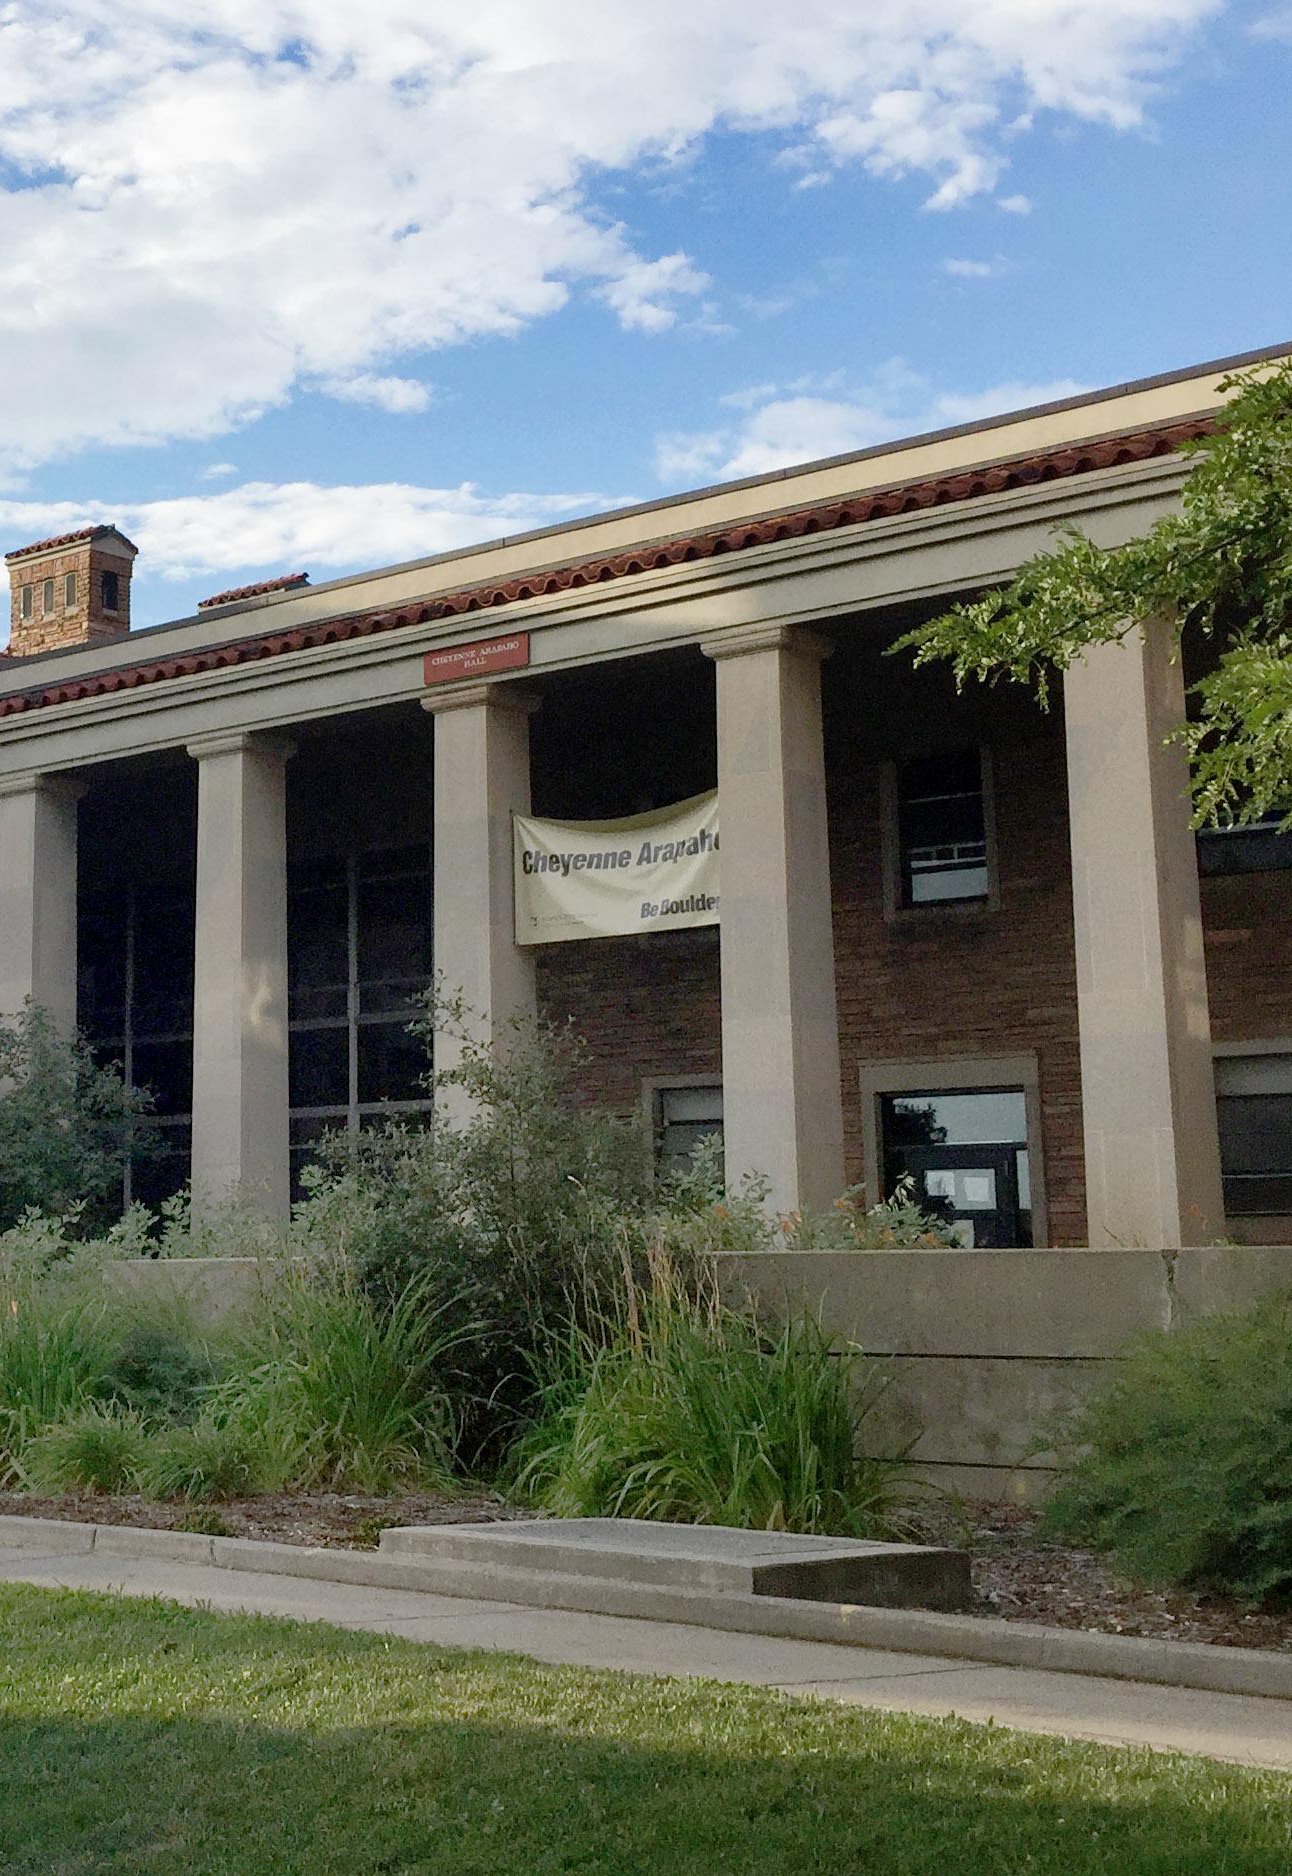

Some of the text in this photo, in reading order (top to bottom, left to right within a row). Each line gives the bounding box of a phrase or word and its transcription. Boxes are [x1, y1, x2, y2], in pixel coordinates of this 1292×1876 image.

[431, 650, 476, 666] CHEYENNE
[464, 657, 487, 668] HALL
[522, 850, 630, 876] Cheyenne
